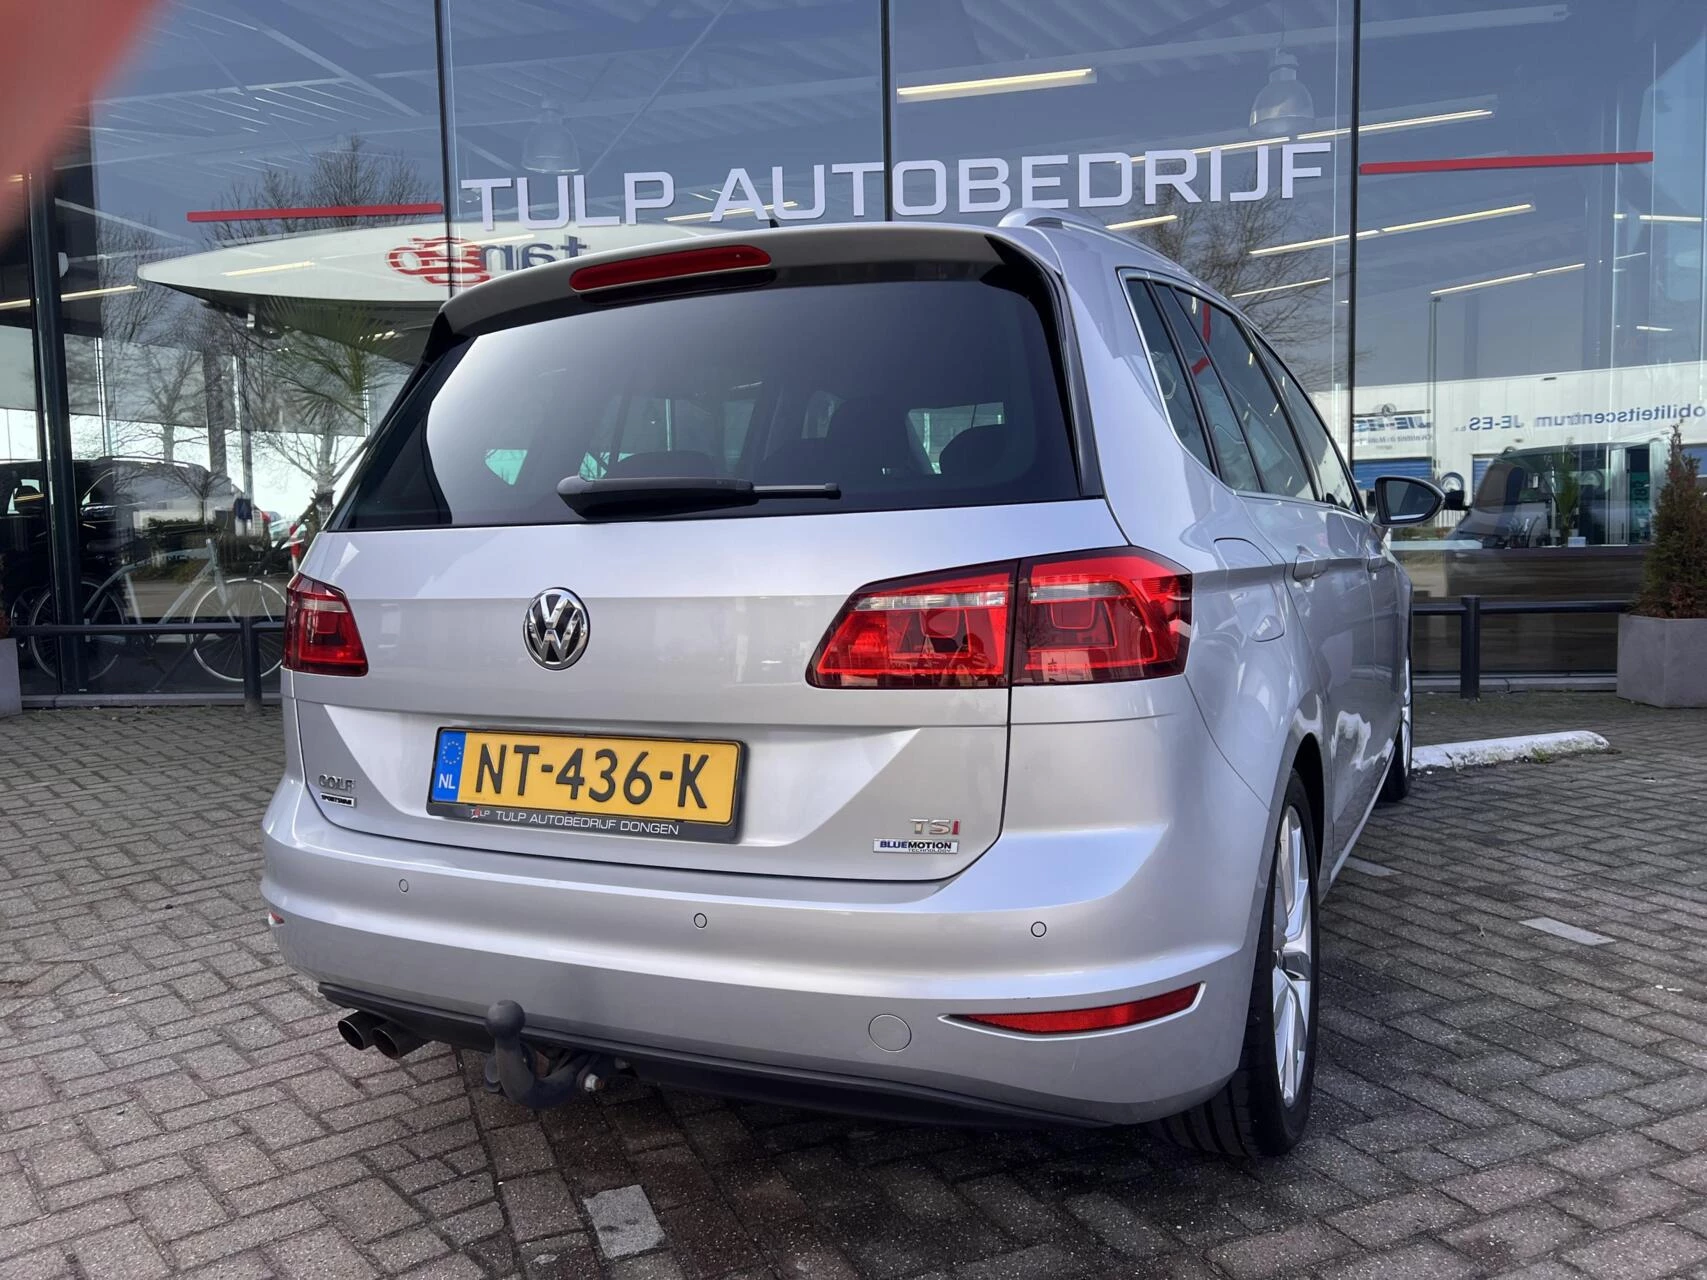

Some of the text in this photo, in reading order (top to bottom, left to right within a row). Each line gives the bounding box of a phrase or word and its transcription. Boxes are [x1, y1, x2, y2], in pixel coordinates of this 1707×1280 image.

[461, 142, 1331, 231] TULP AUTOBEDRIJF
[523, 587, 591, 671] VW
[319, 774, 355, 793] GOLF
[438, 773, 456, 790] NL
[475, 743, 709, 809] NT-436-K
[496, 810, 527, 823] TULP
[529, 813, 617, 830] AUTOBEDRIJF
[620, 820, 679, 835] DONGEN
[909, 818, 960, 835] TSI
[880, 840, 952, 850] BLUEMOTION
